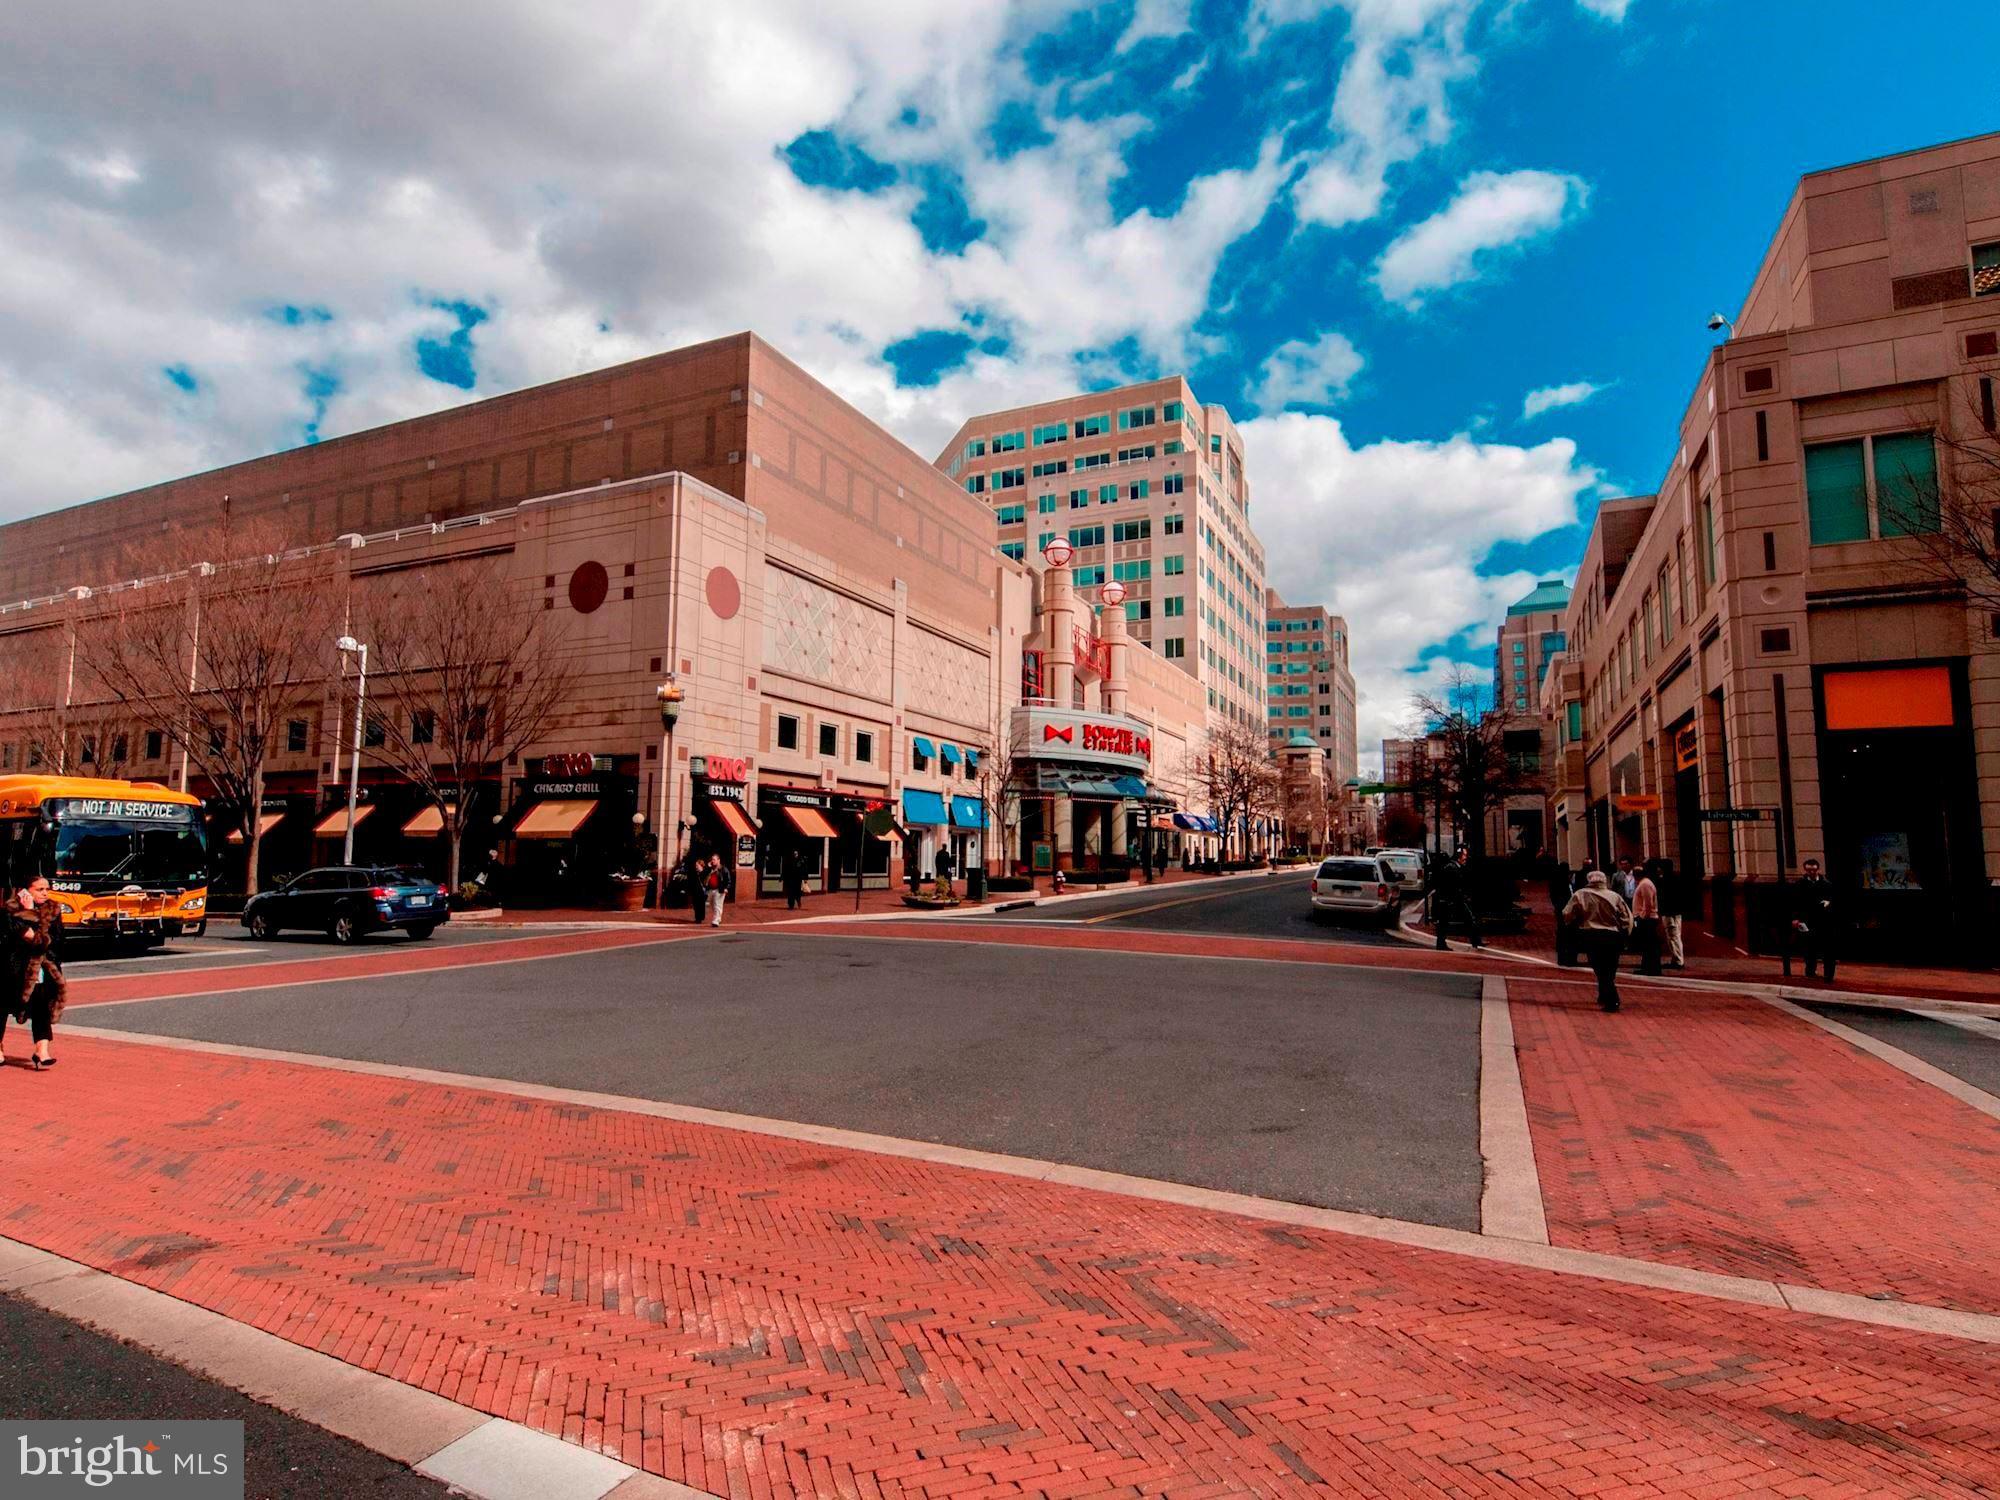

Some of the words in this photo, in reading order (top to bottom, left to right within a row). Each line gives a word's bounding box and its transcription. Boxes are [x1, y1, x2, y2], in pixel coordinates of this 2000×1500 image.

[545, 753, 593, 778] UNO
[707, 756, 746, 782] UNO
[533, 783, 573, 794] CHICAGO
[574, 782, 601, 793] GRILL
[708, 785, 725, 797] EST.
[786, 794, 808, 804] CHICAGO
[807, 796, 820, 805] GRILL
[81, 800, 106, 814] NOT
[108, 801, 123, 815] IN
[125, 803, 174, 818] SERVICE
[52, 882, 82, 892] 9649
